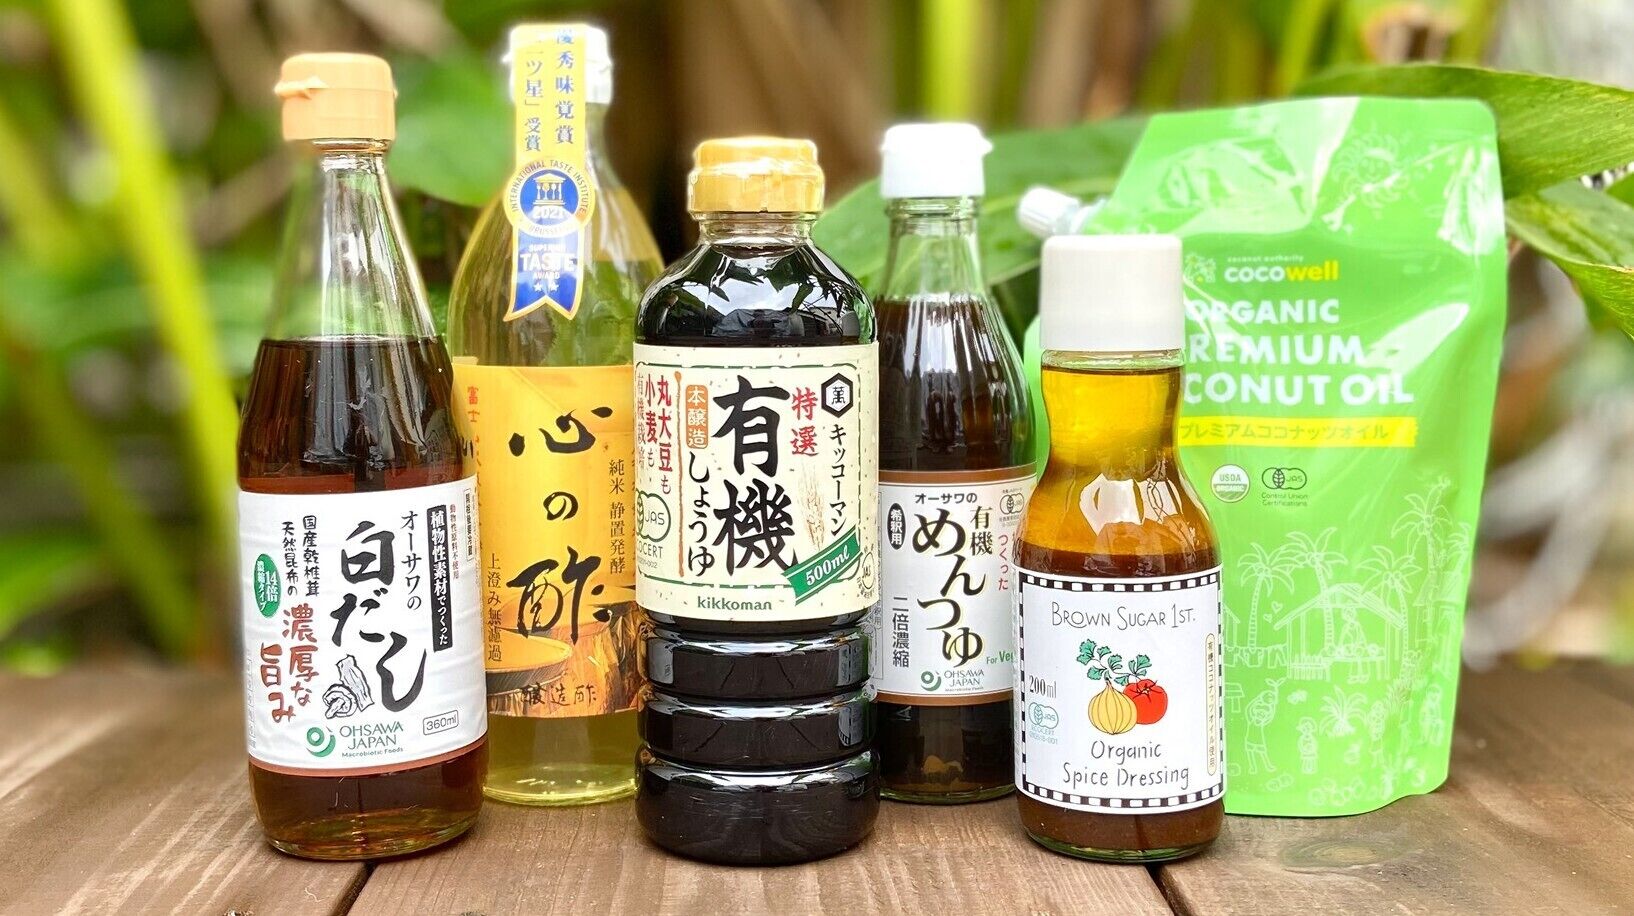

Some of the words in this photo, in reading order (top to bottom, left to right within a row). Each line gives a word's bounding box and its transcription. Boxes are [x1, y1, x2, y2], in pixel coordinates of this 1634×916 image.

[509, 160, 546, 213] INTERNATIONAL
[549, 160, 573, 173] TASTE
[573, 172, 590, 214] INSTITUTE
[519, 253, 577, 272] TASTE
[1224, 260, 1339, 283] cocowell
[1185, 299, 1341, 325] ORGANIC
[1188, 335, 1365, 366] REMIUM
[1184, 373, 1331, 406] CONUT
[1340, 373, 1415, 406] OIL
[657, 374, 673, 495] 丸大豆も
[687, 388, 707, 448] 本醸造
[789, 386, 820, 458] 特選
[711, 374, 798, 577] 有機
[829, 423, 848, 537] キッコーマン
[1219, 473, 1242, 482] USDA
[645, 510, 665, 526] JAS
[688, 451, 716, 577] しょうゆ
[914, 492, 978, 504] オーサワの
[505, 405, 614, 647] 心の酢
[969, 505, 994, 557] 有機
[281, 520, 299, 597] 天然昆布の
[303, 515, 321, 598] 国産乾椎茸
[400, 510, 423, 611] オーサワの
[804, 546, 851, 587] 500ml
[998, 534, 1010, 591] つくった
[430, 510, 450, 647] 植物性素材でつくった
[911, 508, 987, 668] めんつゆ
[329, 520, 428, 713] 白だし
[697, 596, 773, 611] kikkoman
[1051, 601, 1111, 629] BROWN
[1117, 606, 1167, 631] SUGAR
[892, 597, 910, 668] 二倍濃縮
[281, 602, 320, 707] 濃厚な
[943, 669, 985, 679] OHSAWA
[986, 656, 998, 665] For
[260, 642, 297, 724] 旨み
[949, 677, 980, 687] JAPAN
[1028, 674, 1057, 699] 200ml
[339, 720, 404, 738] OHSAWA
[347, 734, 397, 751] JAPAN
[425, 715, 457, 732] 360ml
[1090, 740, 1163, 766] Organic
[1062, 762, 1109, 790] Spice
[1117, 766, 1190, 791] Dressing
